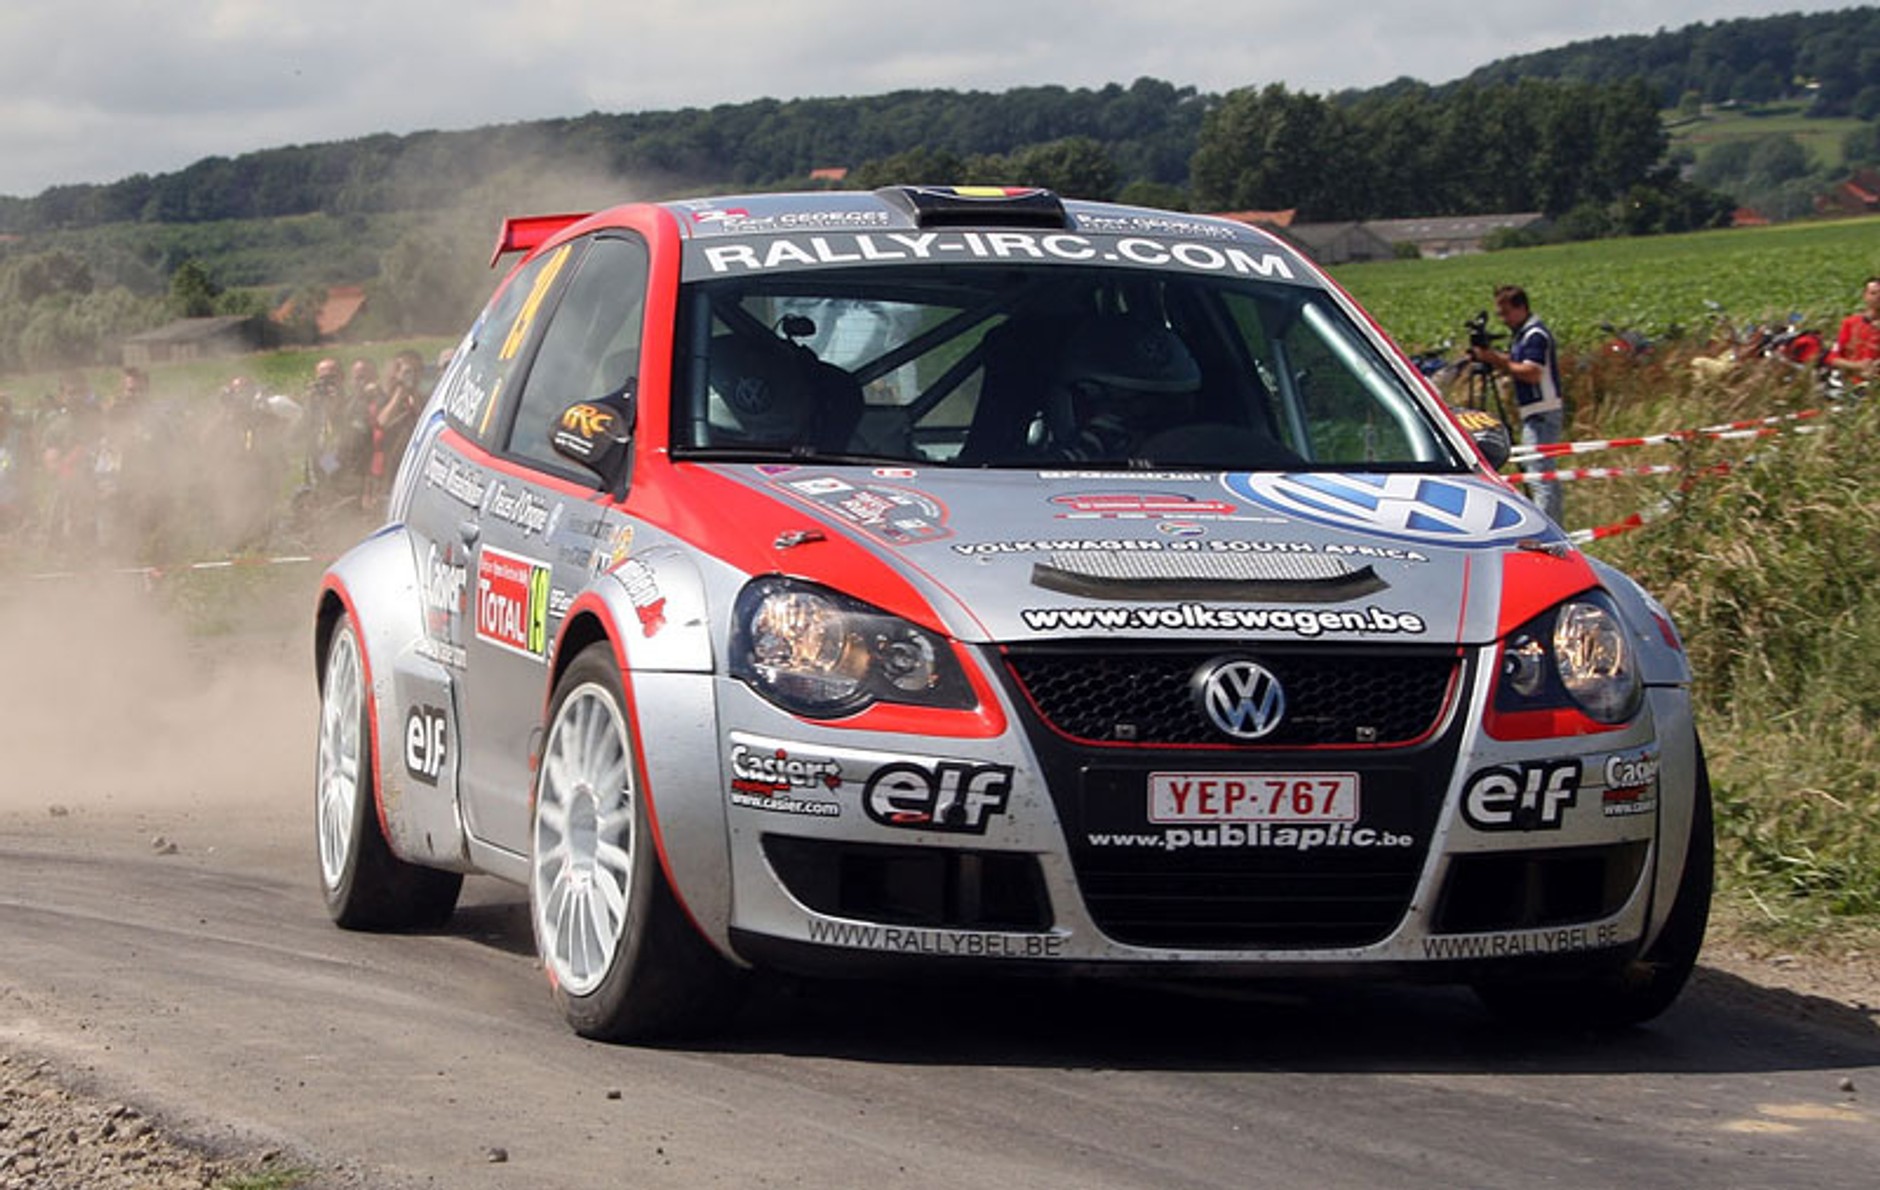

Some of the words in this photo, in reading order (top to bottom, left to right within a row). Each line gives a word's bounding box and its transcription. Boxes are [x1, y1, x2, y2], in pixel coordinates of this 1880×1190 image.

[703, 232, 1295, 279] RALLY-IRC.COM
[953, 539, 1162, 555] VOLKSWAGEN
[1207, 540, 1316, 553] SOUTH
[1324, 543, 1431, 562] AFRICA
[1021, 605, 1426, 635] www.volkswagen.be
[405, 709, 447, 783] elf
[731, 745, 832, 788] Casier
[731, 792, 840, 817] www.casier.com
[865, 764, 1011, 830] elf
[1462, 763, 1580, 828] elf
[808, 919, 1064, 957] WWW.RALLYBEL.BE
[1421, 923, 1619, 959] WWW.RALLYBEL.BE
